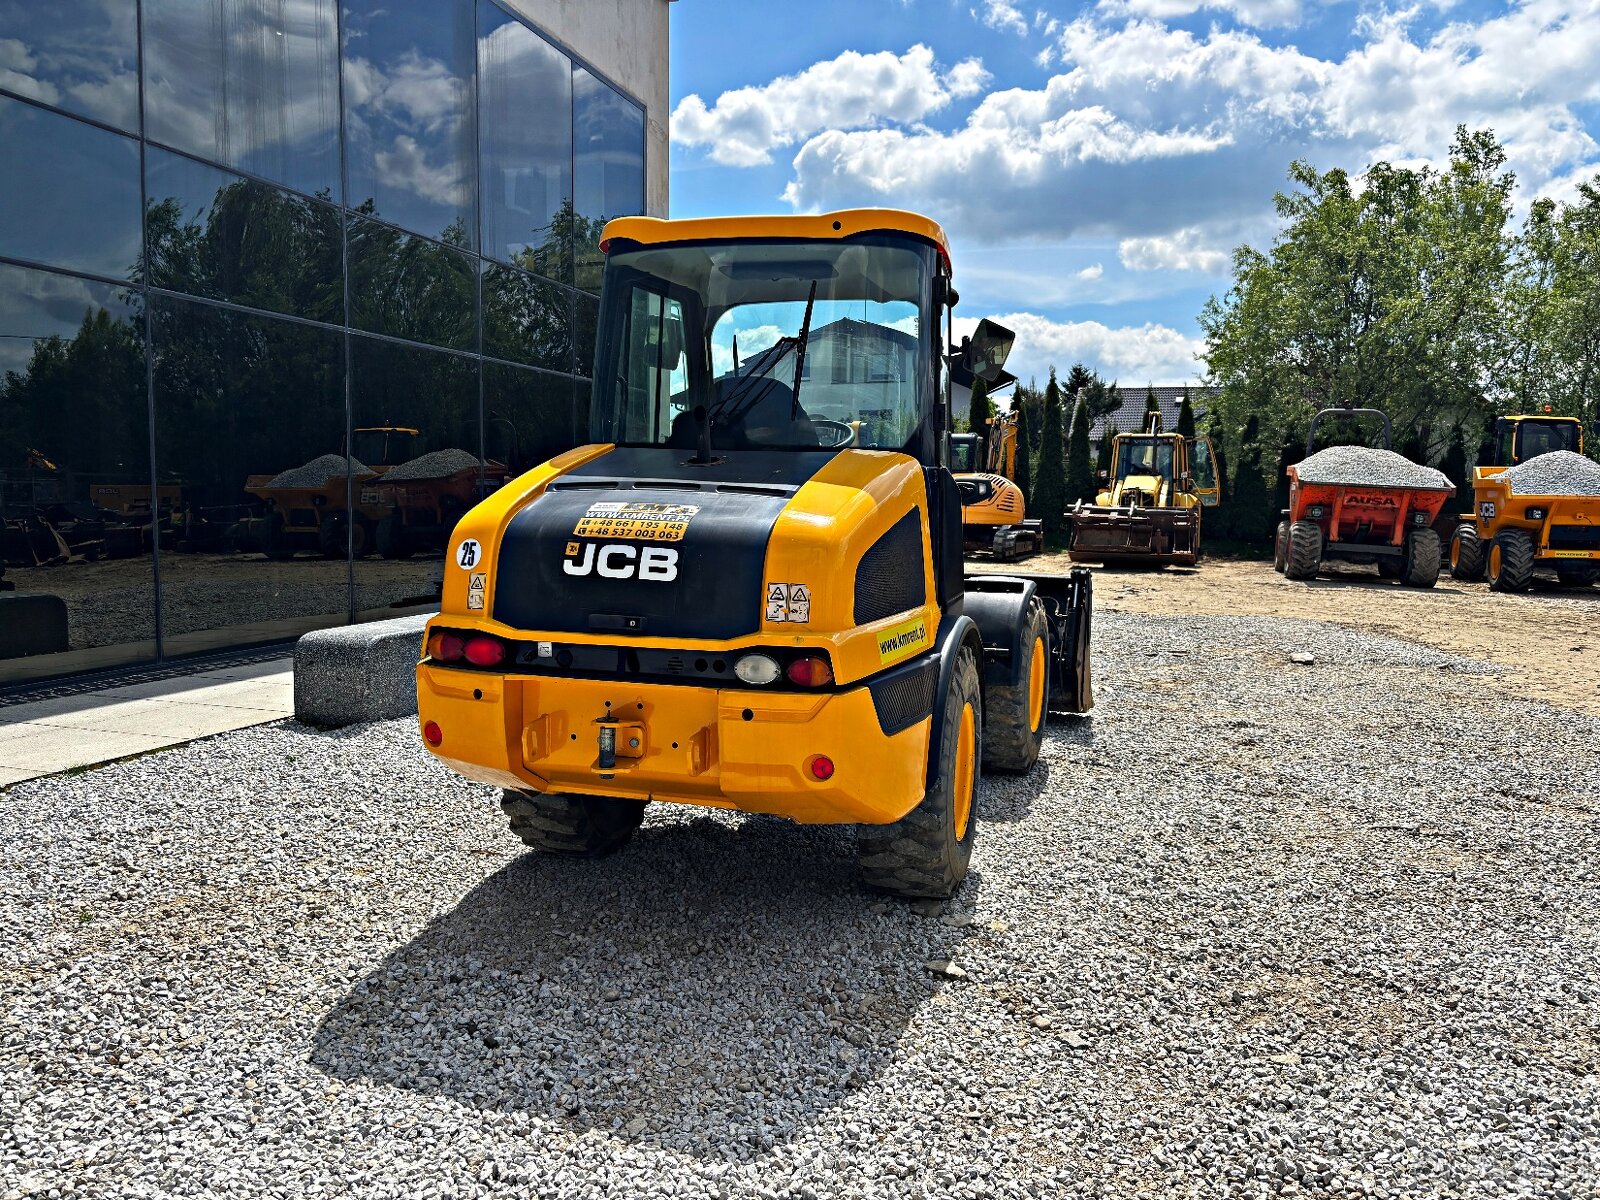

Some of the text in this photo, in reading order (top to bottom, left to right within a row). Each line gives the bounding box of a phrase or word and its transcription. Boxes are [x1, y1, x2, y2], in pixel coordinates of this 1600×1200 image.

[1346, 495, 1396, 506] AUSA
[1480, 502, 1495, 517] JCB
[585, 511, 692, 522] WWW.KMRENT.PL
[640, 521, 660, 529] 195
[663, 522, 683, 531] 148
[588, 528, 679, 539] +48 537 003 063
[460, 541, 477, 567] 25
[563, 543, 678, 582] JCB
[880, 624, 926, 654] www.kmrent.pl
